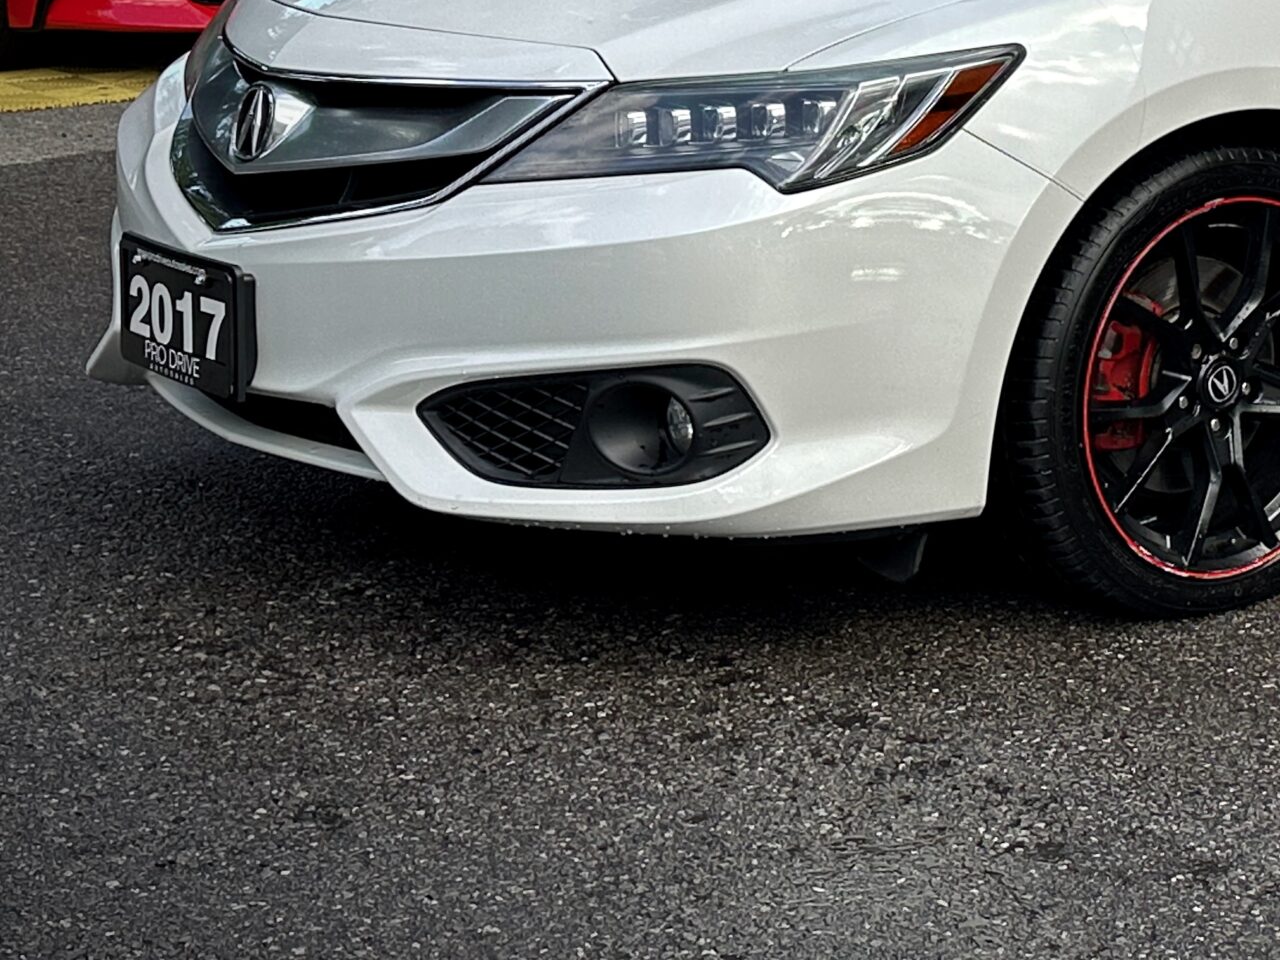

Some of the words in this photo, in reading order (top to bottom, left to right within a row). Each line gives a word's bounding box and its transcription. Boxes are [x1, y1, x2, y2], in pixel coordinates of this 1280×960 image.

[129, 274, 226, 360] 2017
[144, 339, 167, 365] PRO
[168, 348, 201, 378] DRIVE
